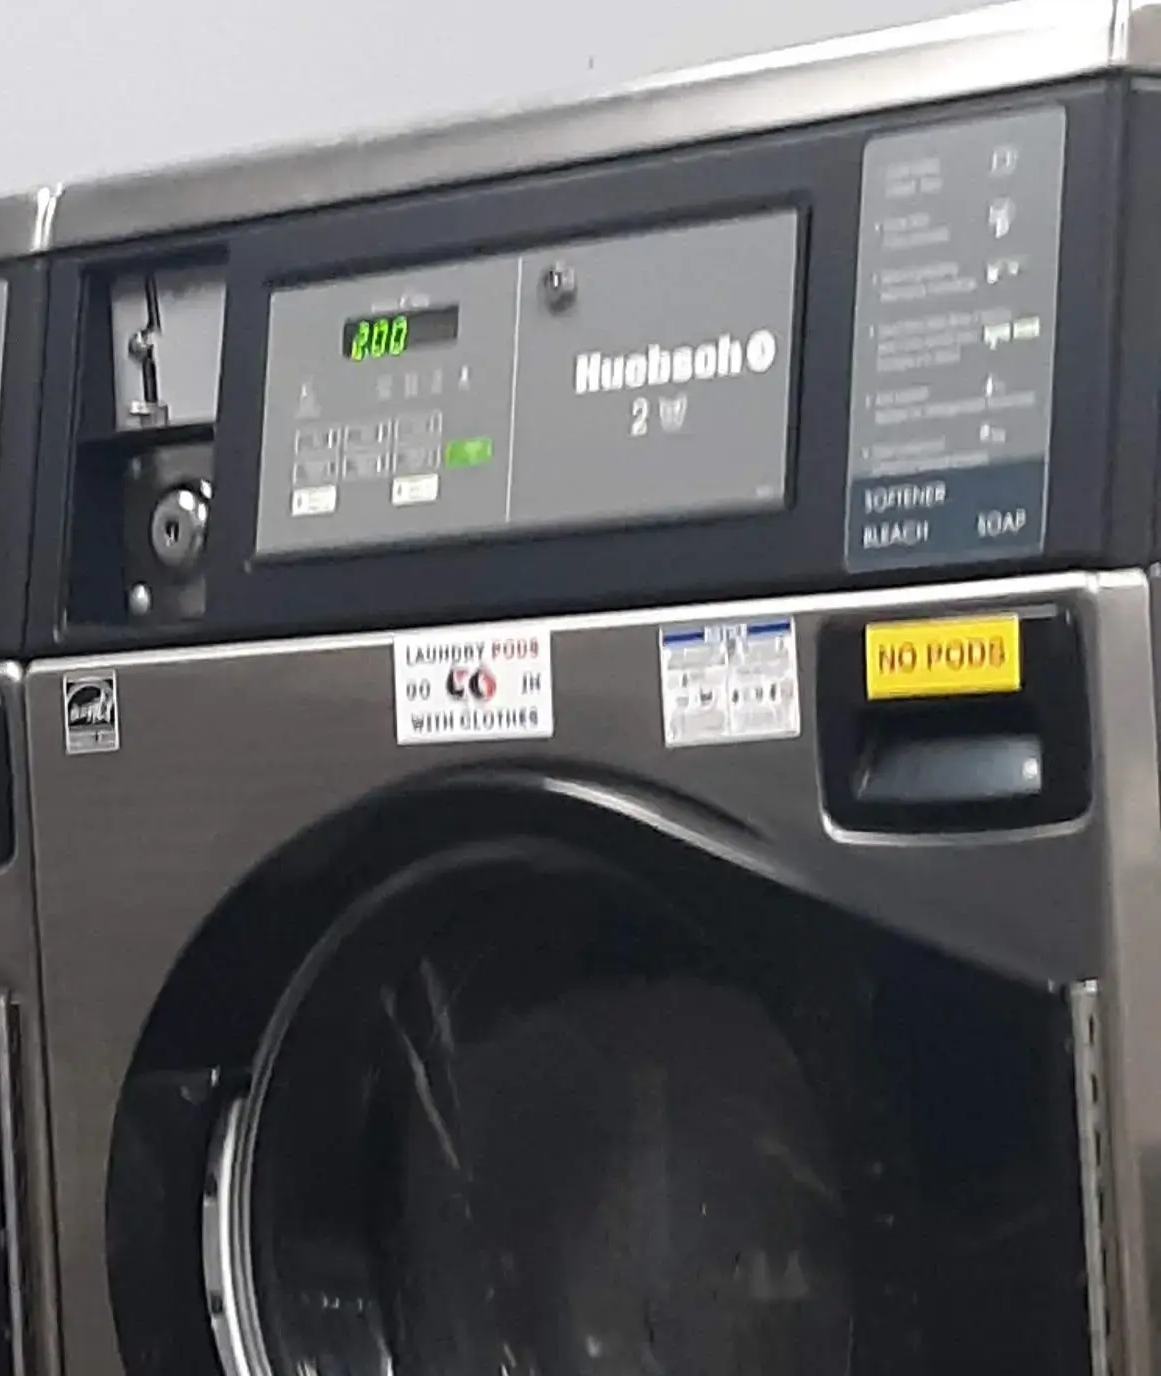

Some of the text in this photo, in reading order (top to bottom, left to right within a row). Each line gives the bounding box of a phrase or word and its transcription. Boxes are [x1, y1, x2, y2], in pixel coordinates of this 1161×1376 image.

[575, 333, 743, 395] Huebsch
[630, 396, 649, 437] 2
[976, 507, 1027, 538] SOAP
[405, 637, 539, 666] LAUNDRY PODS
[878, 635, 1006, 675] NO PODS
[411, 705, 539, 734] WITH CLOTHES
